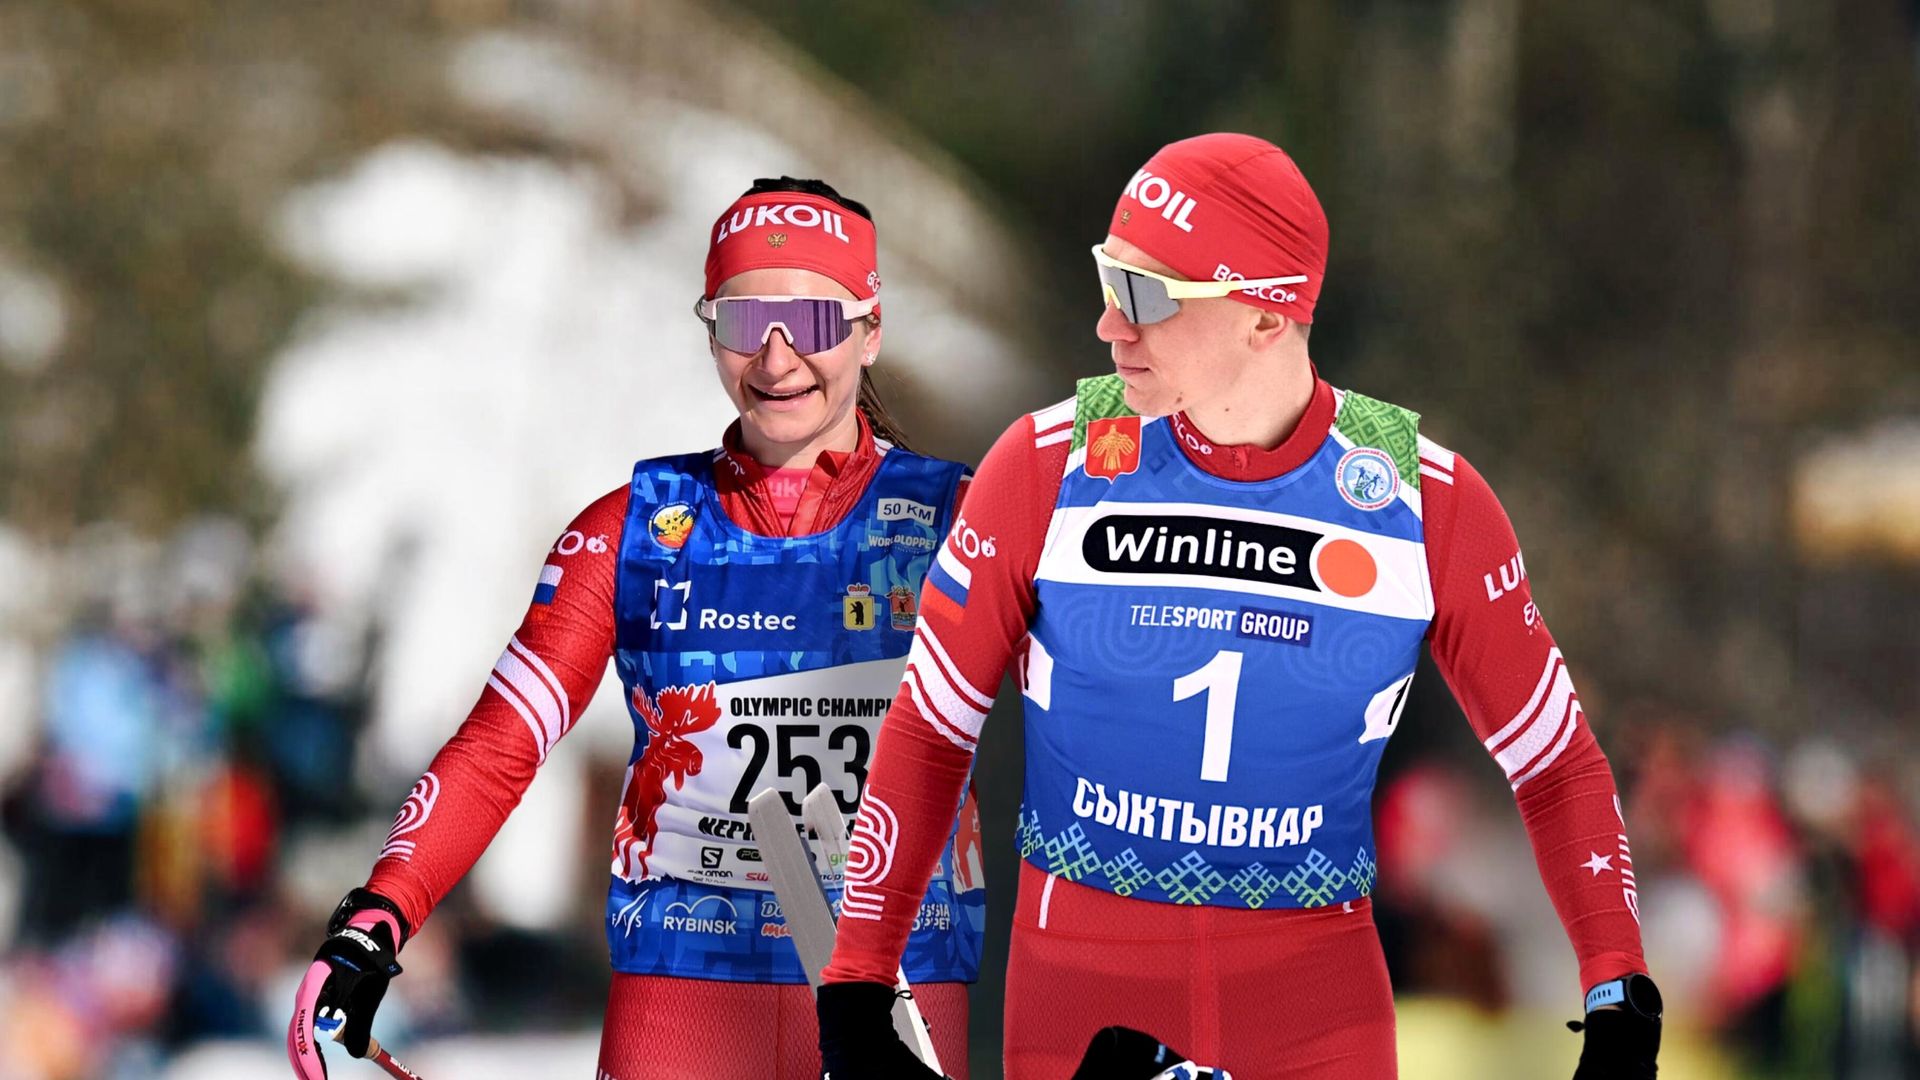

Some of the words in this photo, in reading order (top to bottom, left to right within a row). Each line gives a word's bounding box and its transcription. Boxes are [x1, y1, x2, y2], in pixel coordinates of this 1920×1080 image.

[716, 204, 850, 245] LUKOIL
[883, 503, 901, 516] 50
[906, 503, 932, 522] KM
[1105, 525, 1297, 575] Winline
[699, 608, 797, 631] Rostec
[1130, 605, 1236, 631] TELESPORT
[1240, 611, 1310, 641] GROUP
[730, 697, 812, 717] OLYMPIC
[1173, 650, 1243, 782] 1
[726, 723, 871, 816] 253
[1072, 776, 1324, 849] СЫКТЫВКАР
[663, 916, 737, 935] RYBINSK
